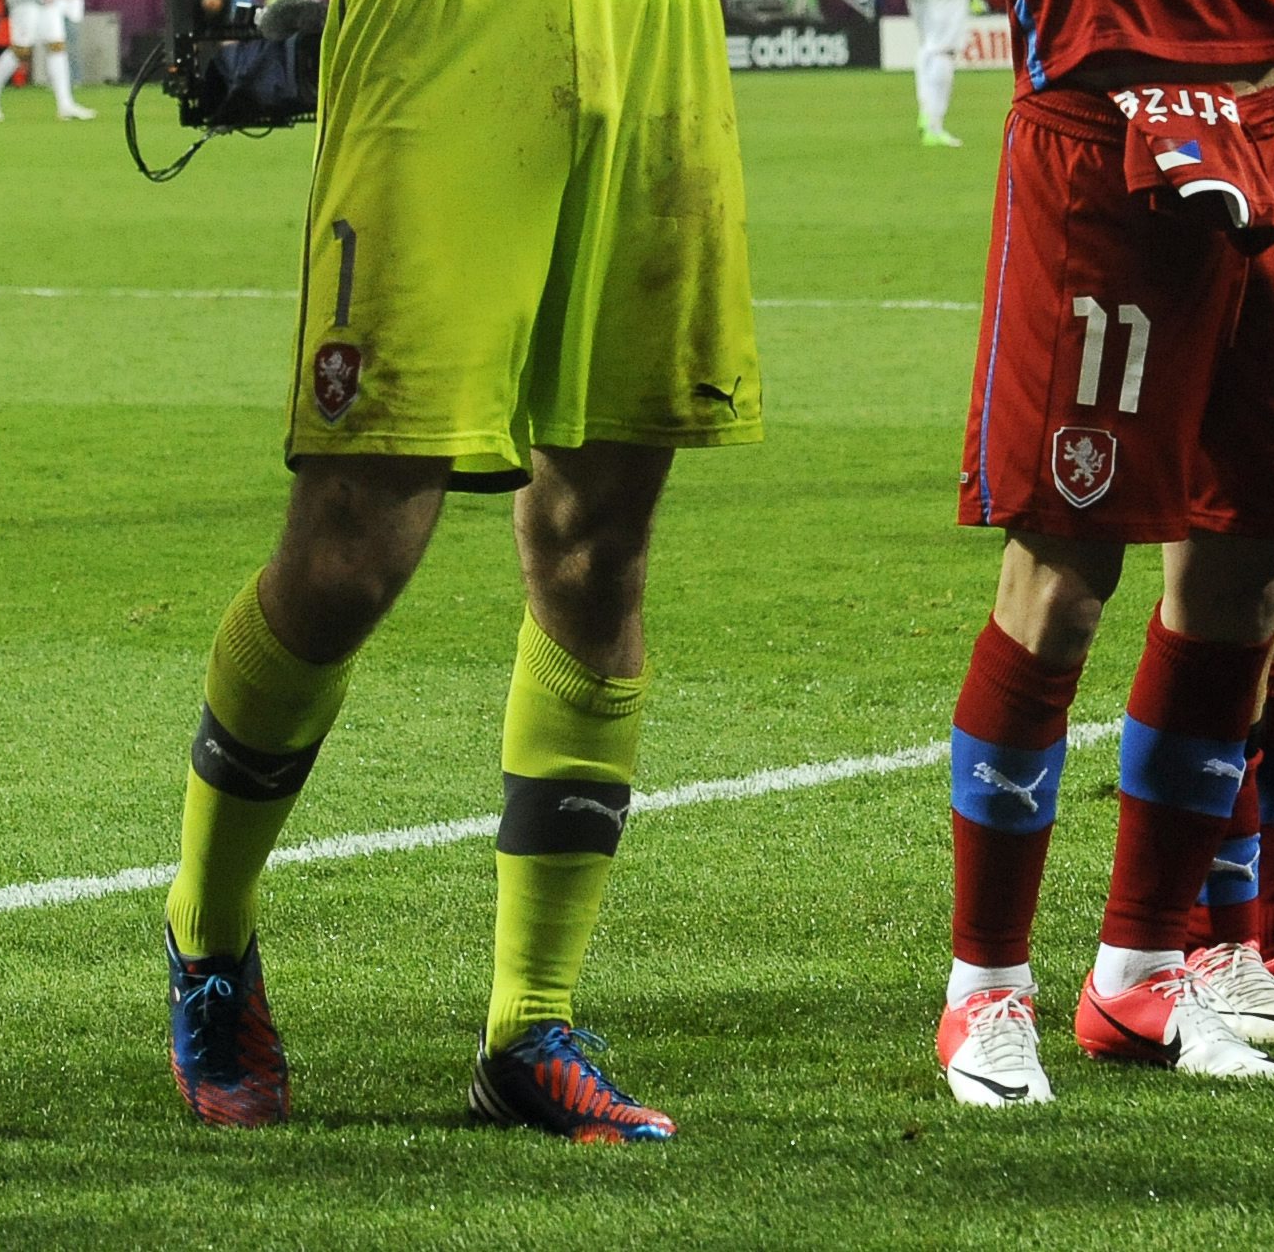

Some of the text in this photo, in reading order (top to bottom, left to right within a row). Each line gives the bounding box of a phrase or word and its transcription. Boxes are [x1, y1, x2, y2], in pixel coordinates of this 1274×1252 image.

[751, 27, 849, 67] adidas
[332, 219, 357, 328] 1
[1072, 296, 1151, 414] 11
